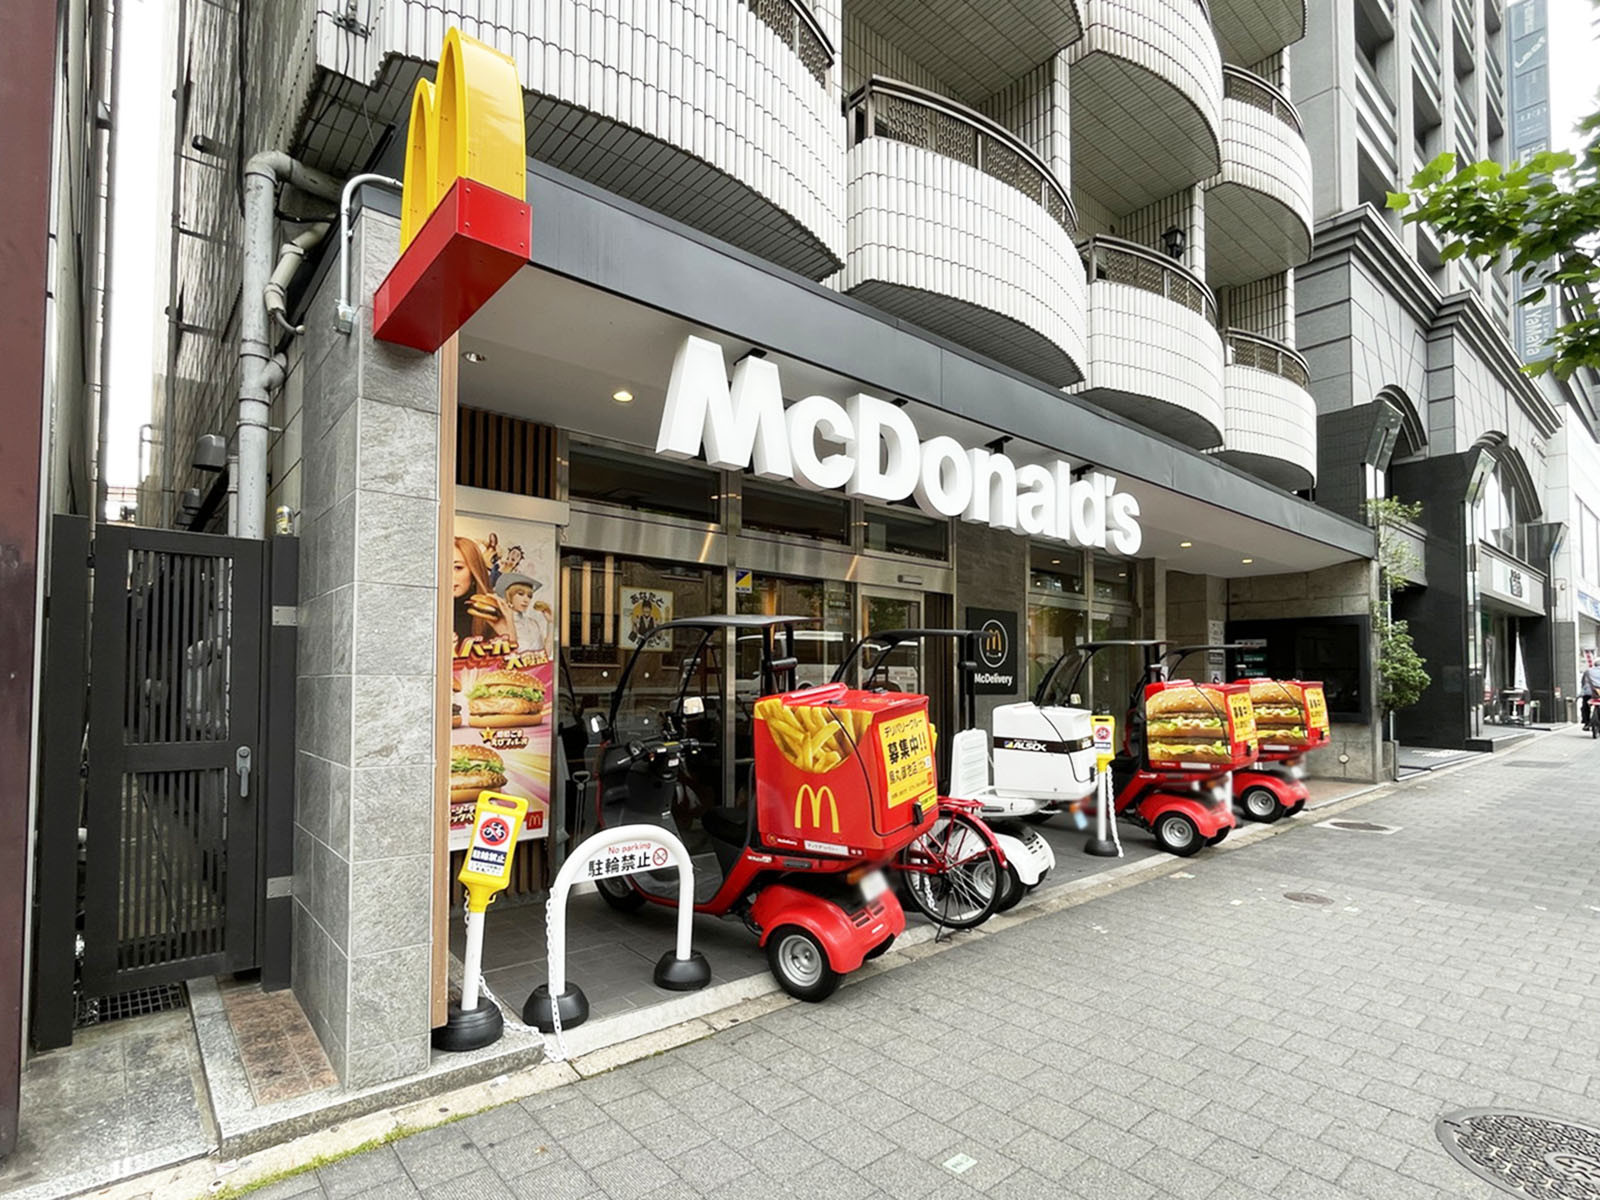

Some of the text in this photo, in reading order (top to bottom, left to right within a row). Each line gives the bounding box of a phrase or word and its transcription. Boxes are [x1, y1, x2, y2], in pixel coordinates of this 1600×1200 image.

[655, 335, 1142, 556] McDonald's
[974, 673, 1013, 686] McDelivery
[608, 842, 651, 854] No parking
[588, 851, 651, 877] 駐輪禁止
